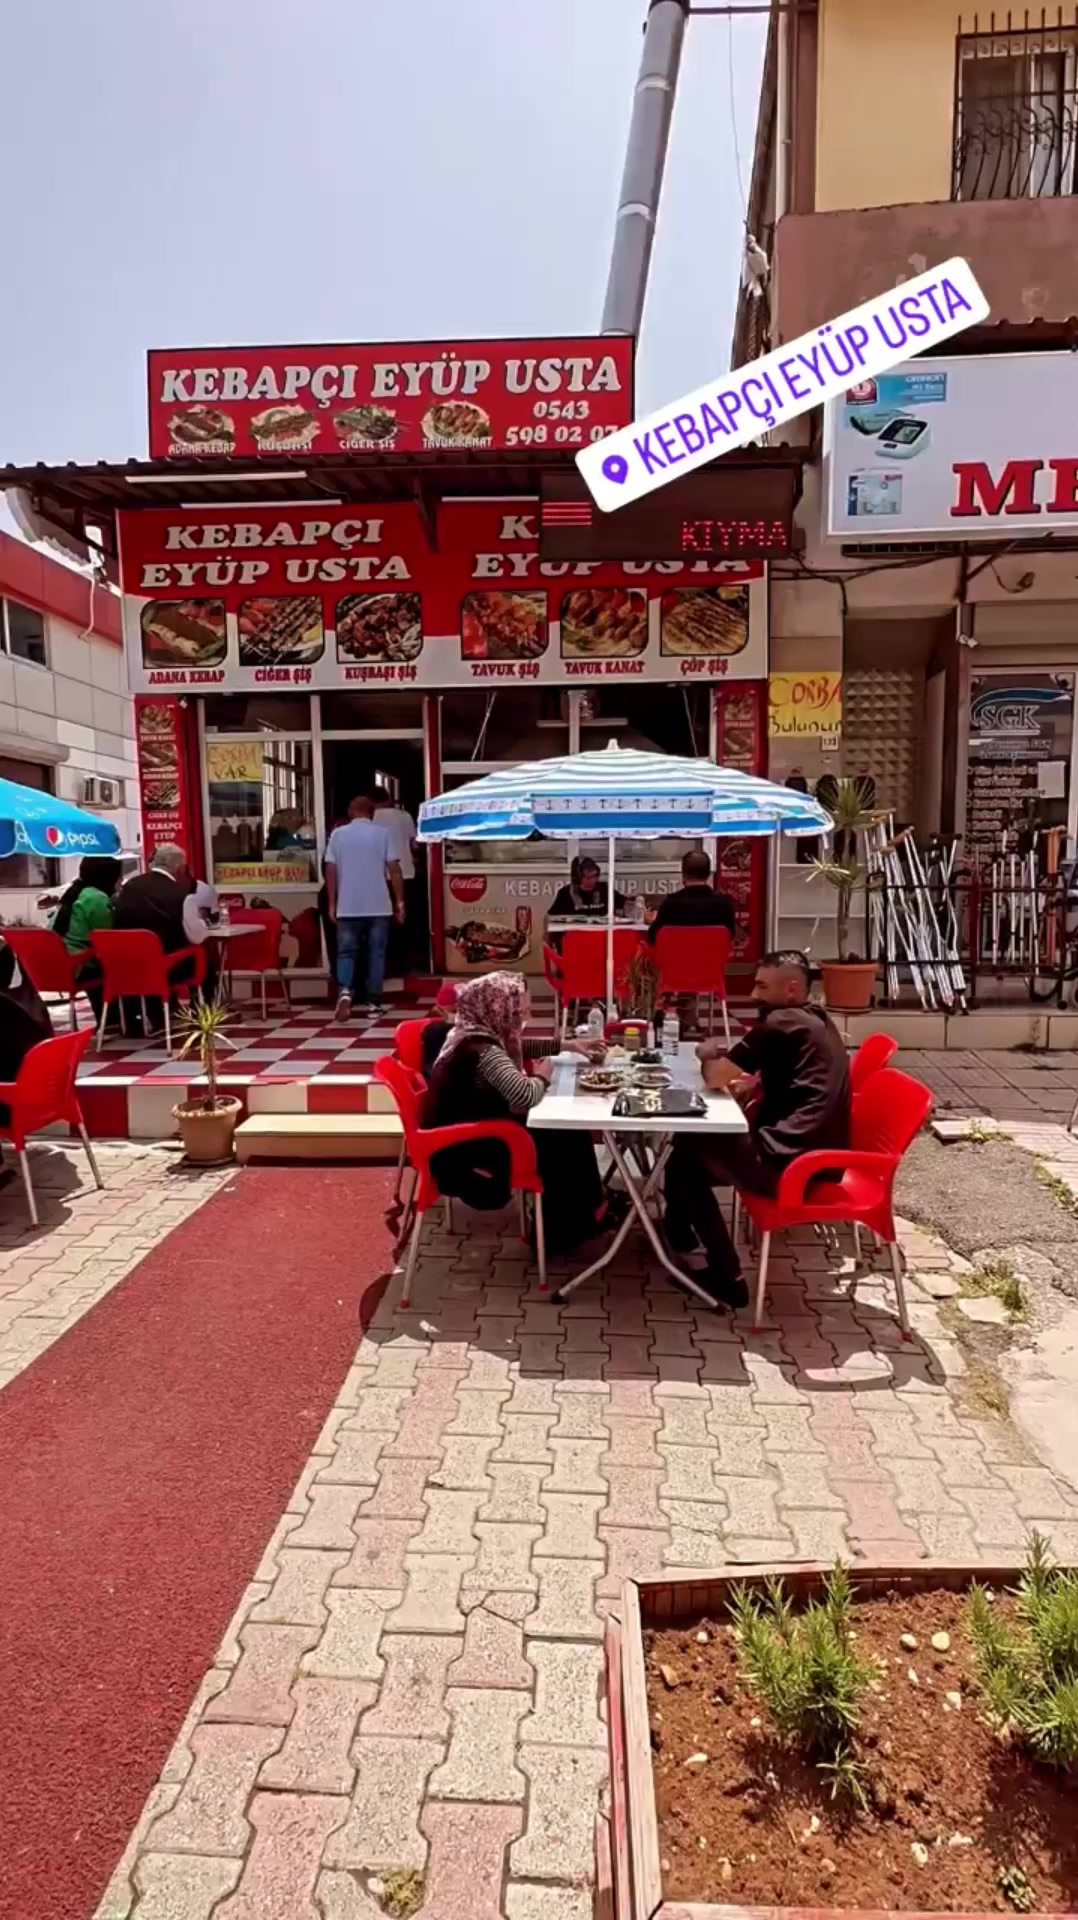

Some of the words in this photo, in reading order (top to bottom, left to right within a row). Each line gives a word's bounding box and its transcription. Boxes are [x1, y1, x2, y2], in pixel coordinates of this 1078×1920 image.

[161, 362, 360, 409] KEBAPÇI
[370, 352, 491, 399] EYÜP
[504, 356, 623, 397] USTA
[533, 400, 591, 421] 0543
[505, 426, 548, 447] 598
[554, 425, 582, 443] 02
[165, 519, 385, 551] KEBAPÇI
[682, 520, 788, 552] KIYMA
[140, 556, 270, 588] EYÜP
[285, 555, 412, 584] USTA
[149, 671, 188, 684] ADANA
[189, 670, 225, 684] KEBAP
[471, 663, 516, 677] TAVUK
[518, 661, 540, 679] ŞİŞ
[564, 661, 603, 675] TAVUK
[604, 660, 645, 675] KANAT
[680, 659, 706, 676] ÇÖP
[708, 658, 729, 676] ŞİŞ
[980, 704, 1041, 730] SGK
[645, 880, 682, 895] UST
